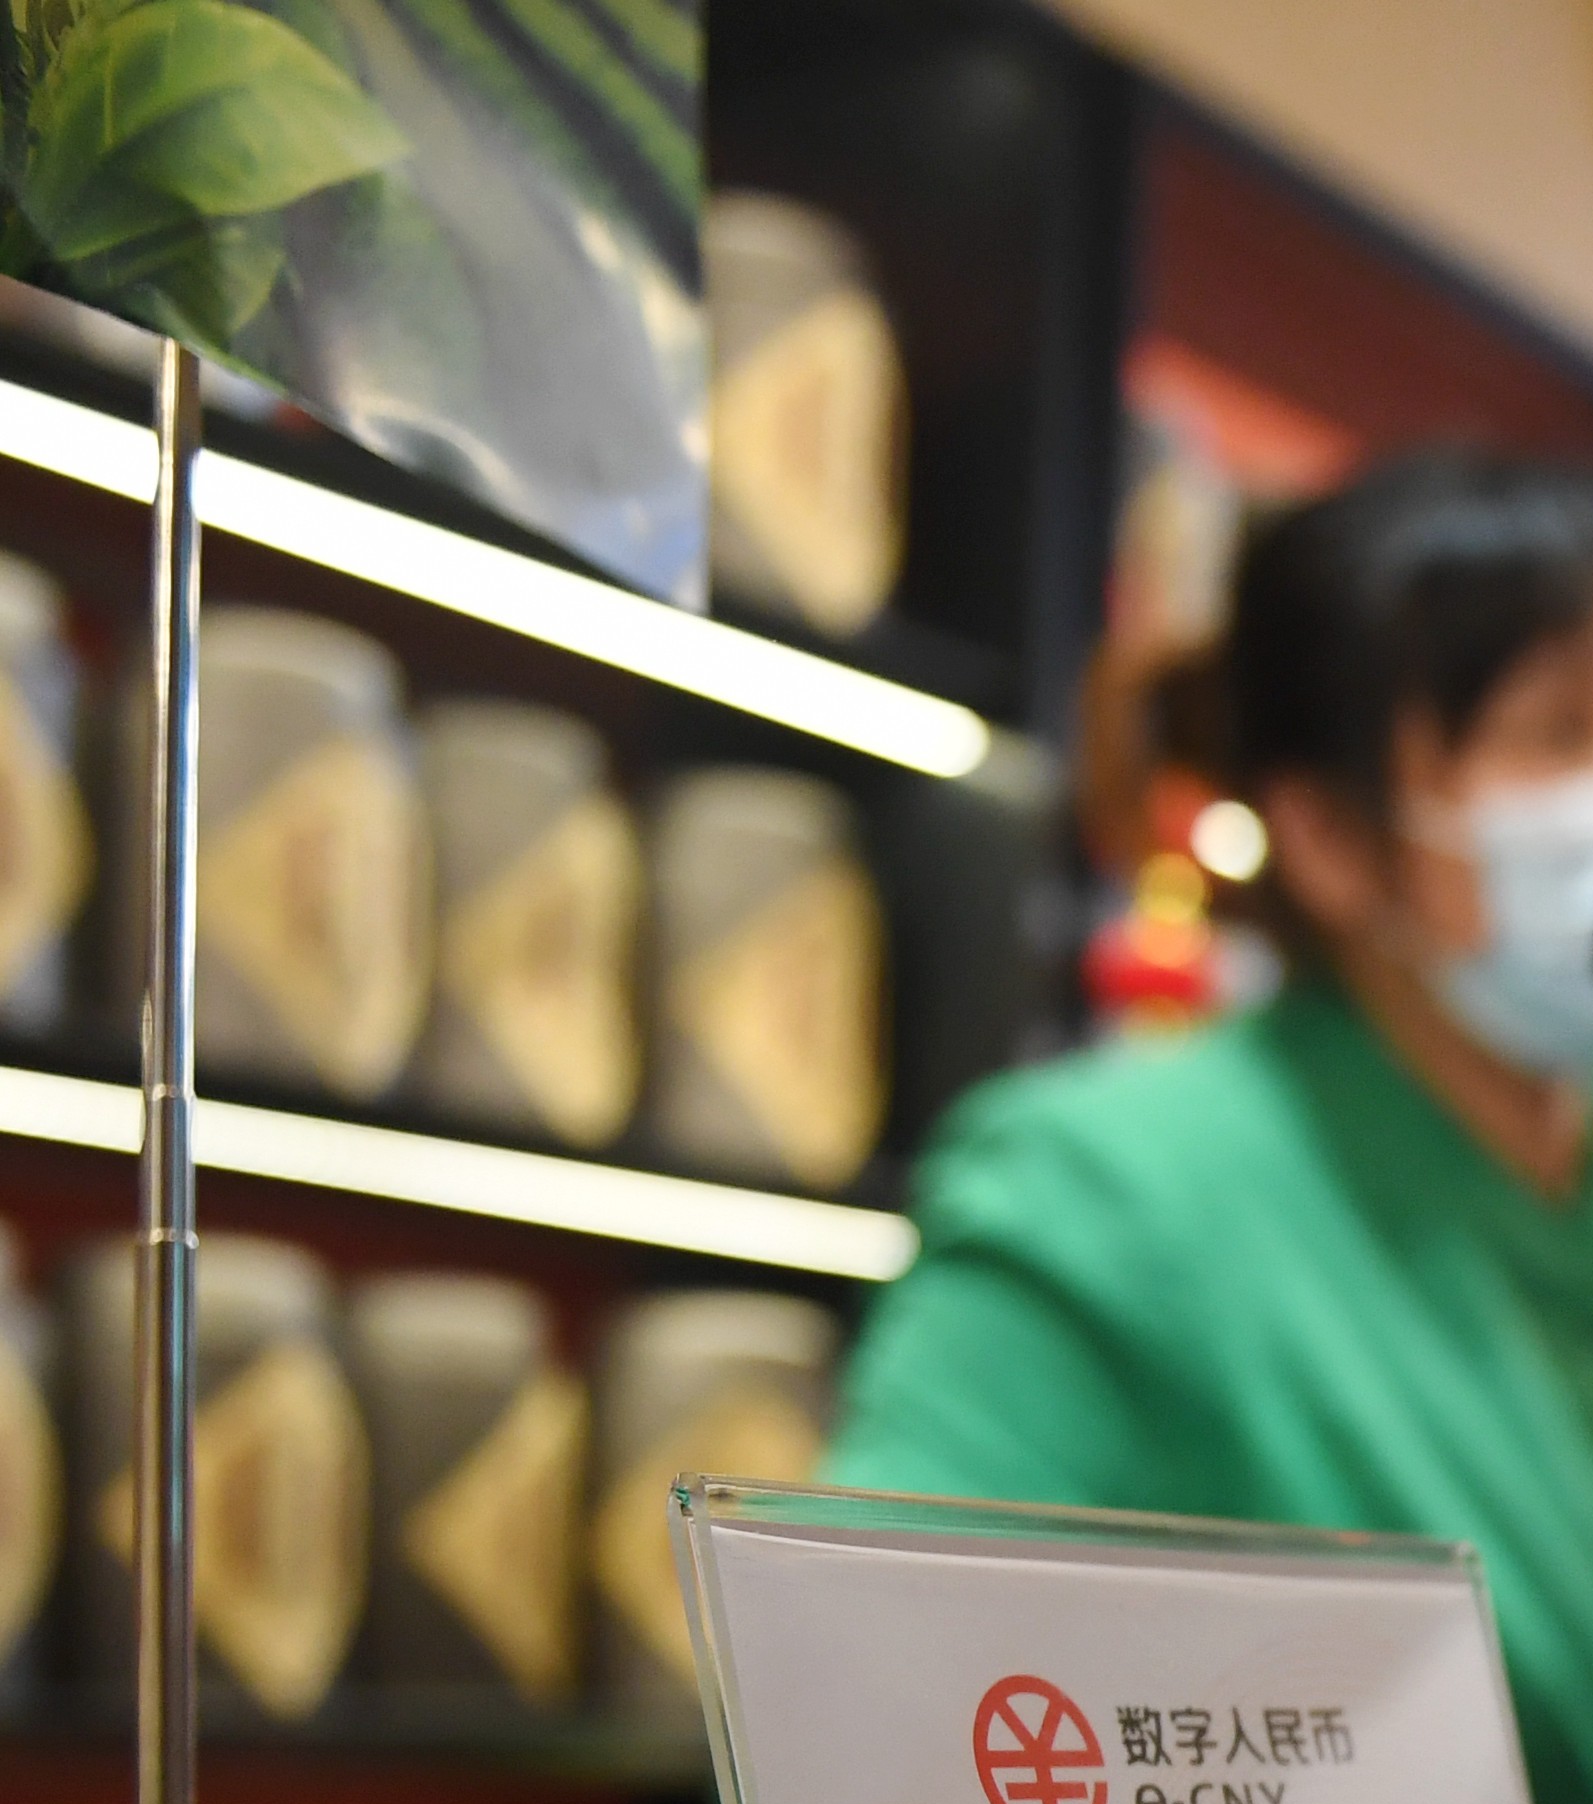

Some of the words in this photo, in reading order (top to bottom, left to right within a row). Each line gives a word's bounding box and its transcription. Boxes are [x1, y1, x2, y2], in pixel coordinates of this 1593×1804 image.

[1115, 1704, 1355, 1767] 数字人民币
